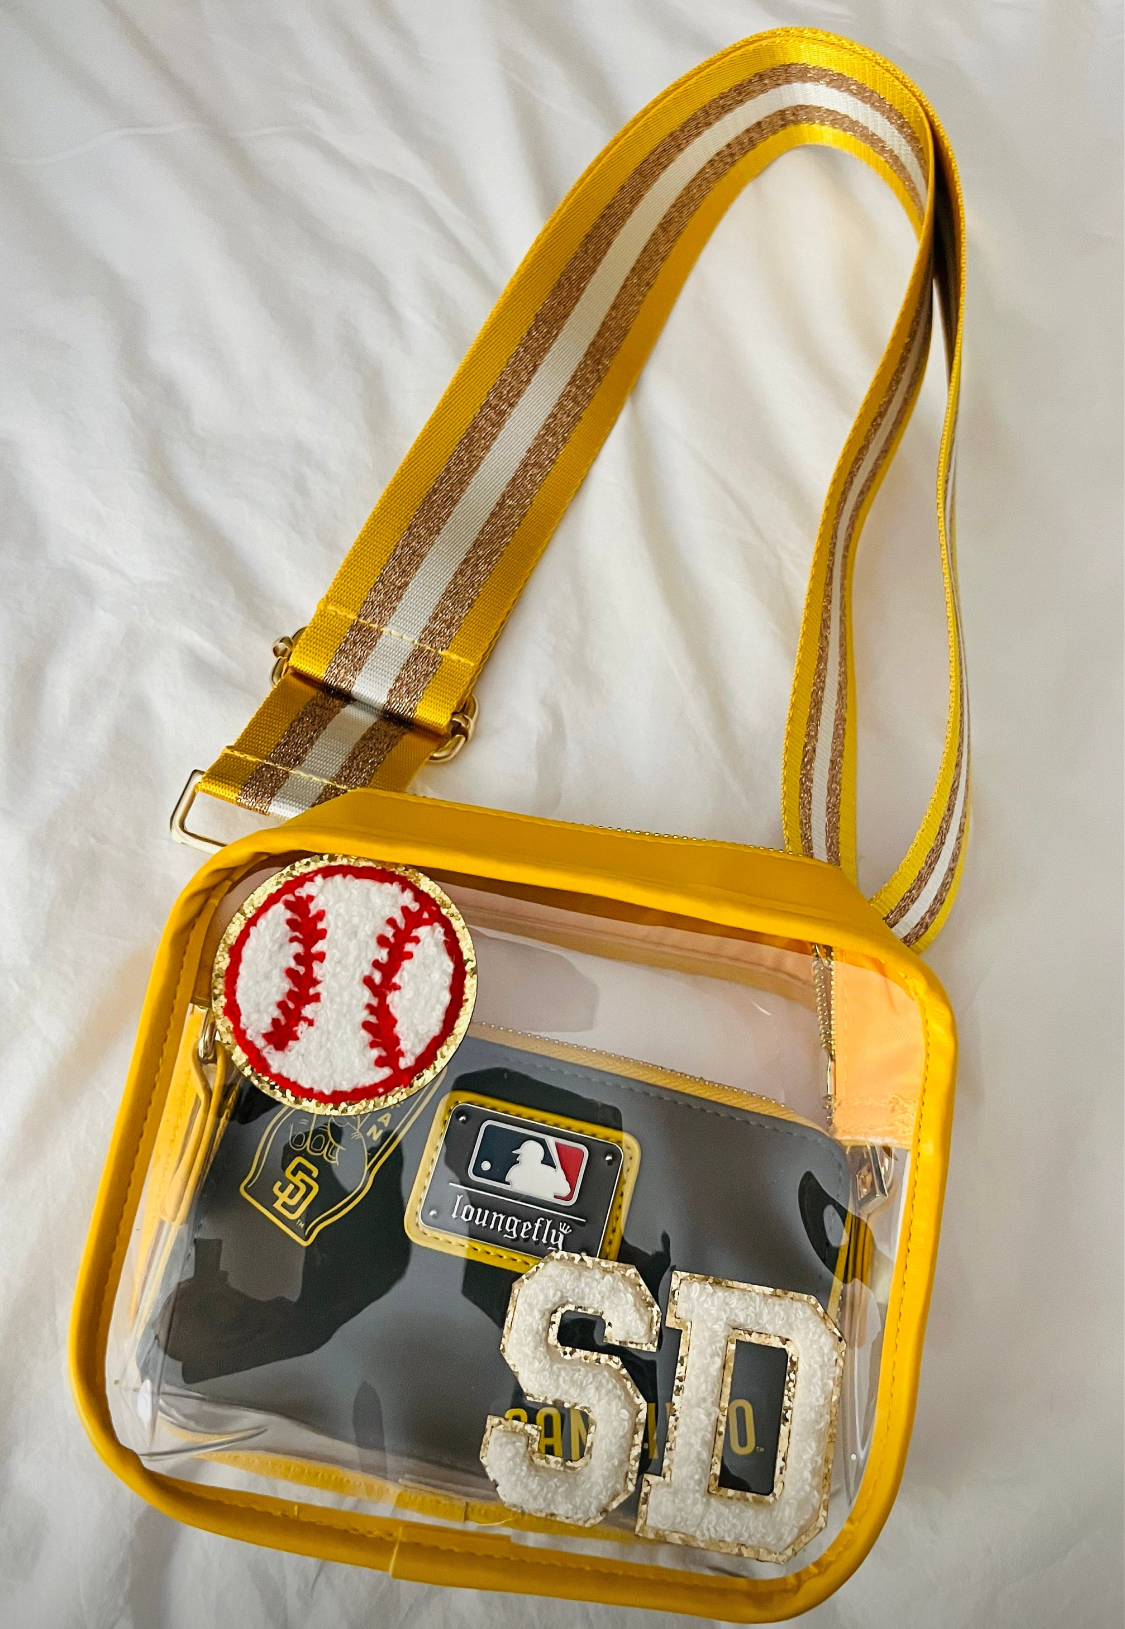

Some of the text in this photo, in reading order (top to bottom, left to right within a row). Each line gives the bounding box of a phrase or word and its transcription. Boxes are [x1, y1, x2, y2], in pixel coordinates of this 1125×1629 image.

[272, 1156, 320, 1220] SD
[451, 1194, 565, 1251] loungefly
[480, 1251, 847, 1564] SD
[504, 1406, 589, 1462] AN
